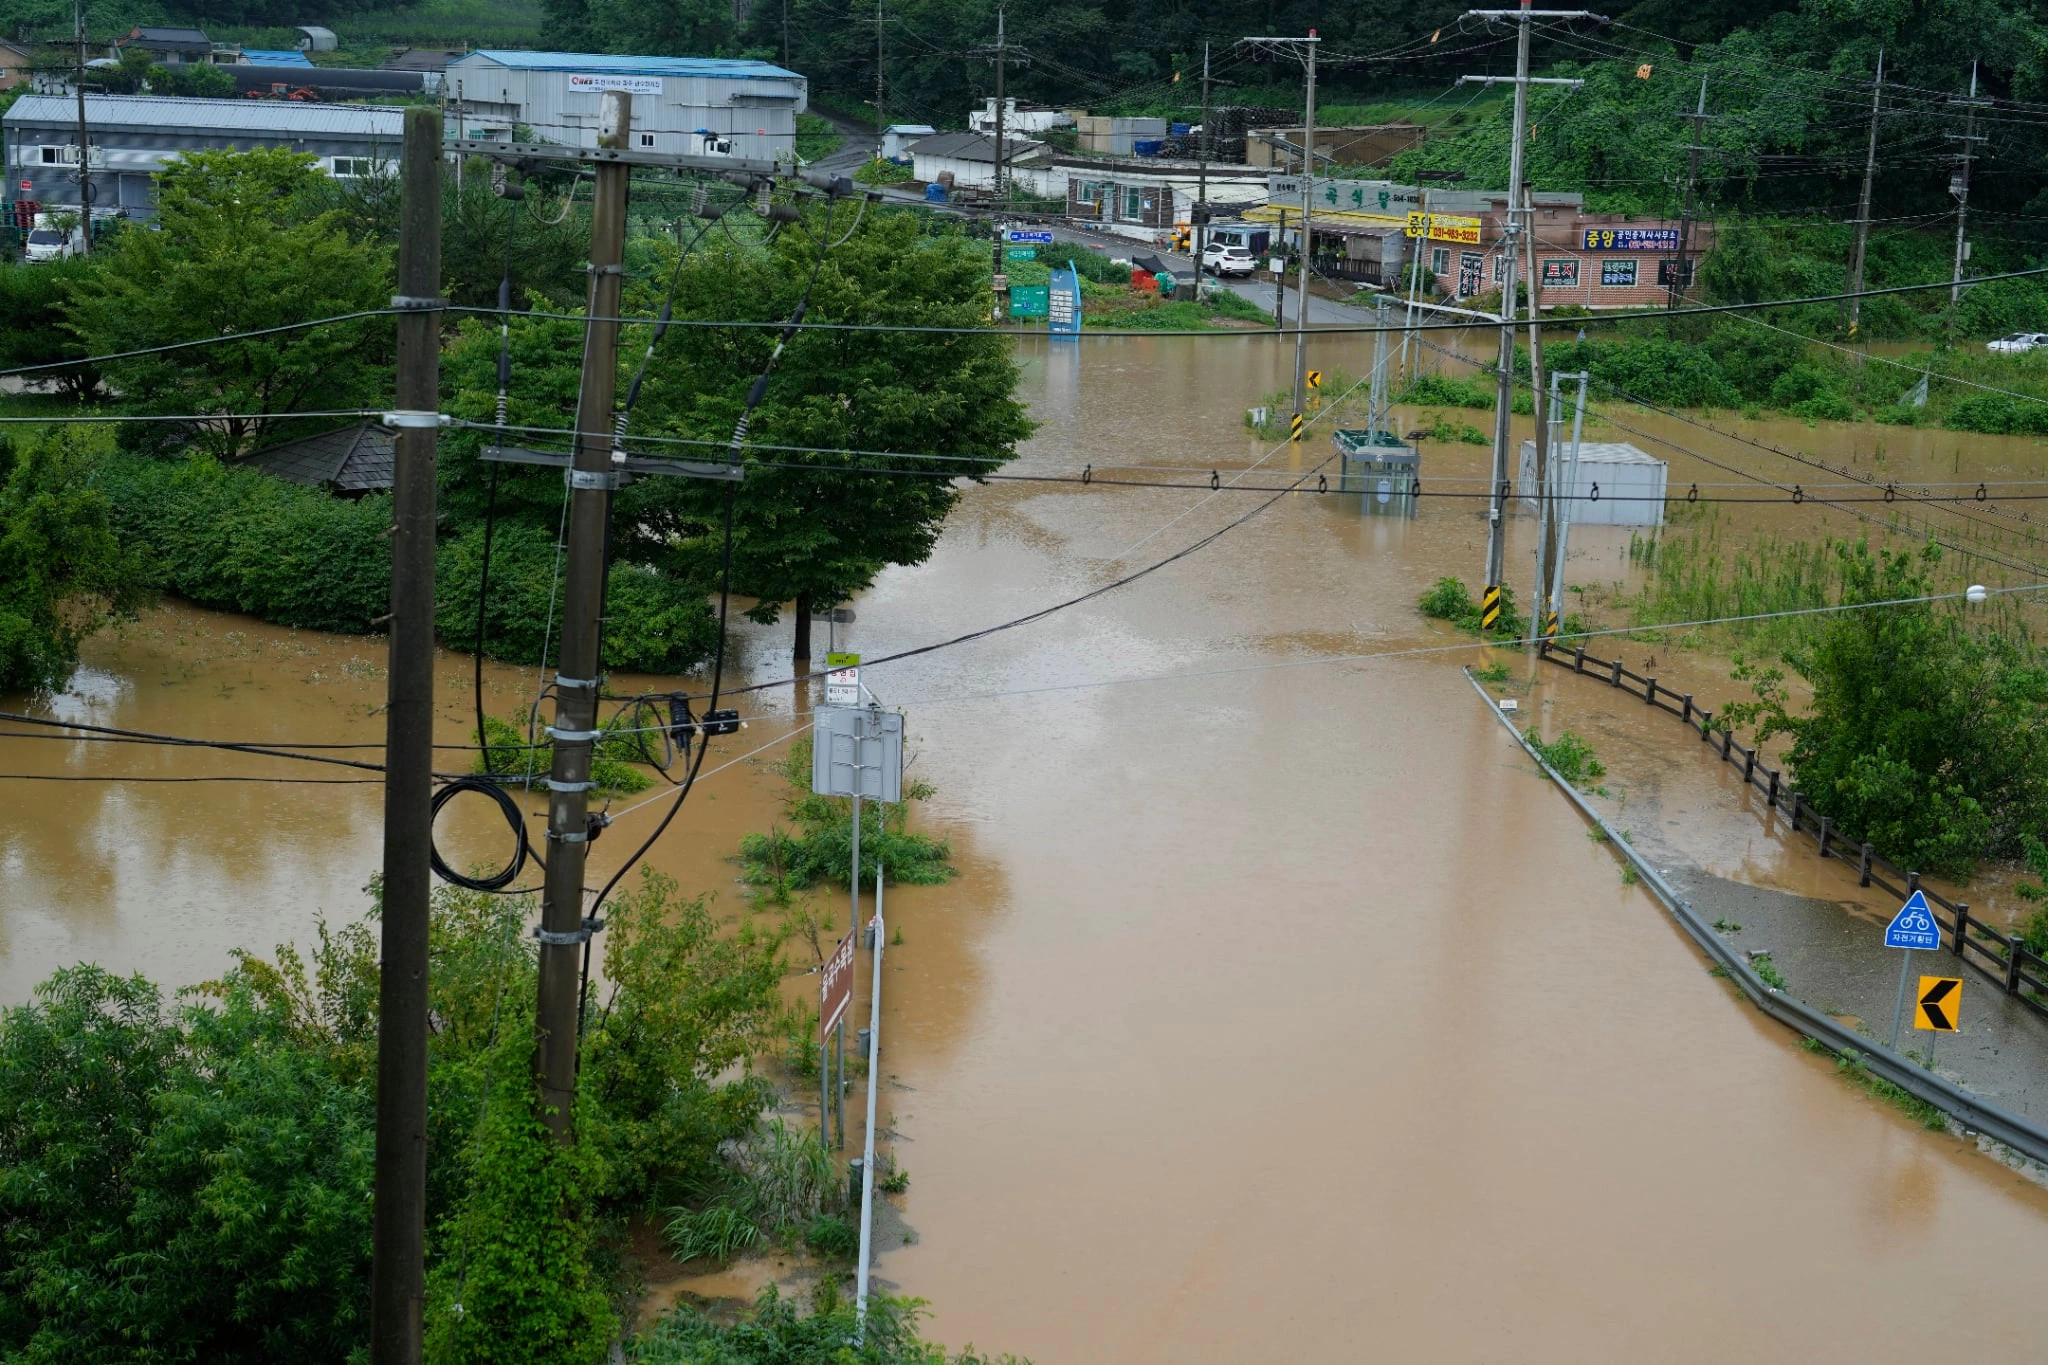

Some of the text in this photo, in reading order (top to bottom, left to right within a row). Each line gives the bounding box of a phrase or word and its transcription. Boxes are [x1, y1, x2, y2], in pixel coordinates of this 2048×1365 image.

[1586, 230, 1616, 249] 중앙
[1616, 230, 1677, 240] 공인중개사사무소
[1546, 262, 1575, 279] 토지
[1892, 934, 1933, 944] 자전거횡단
